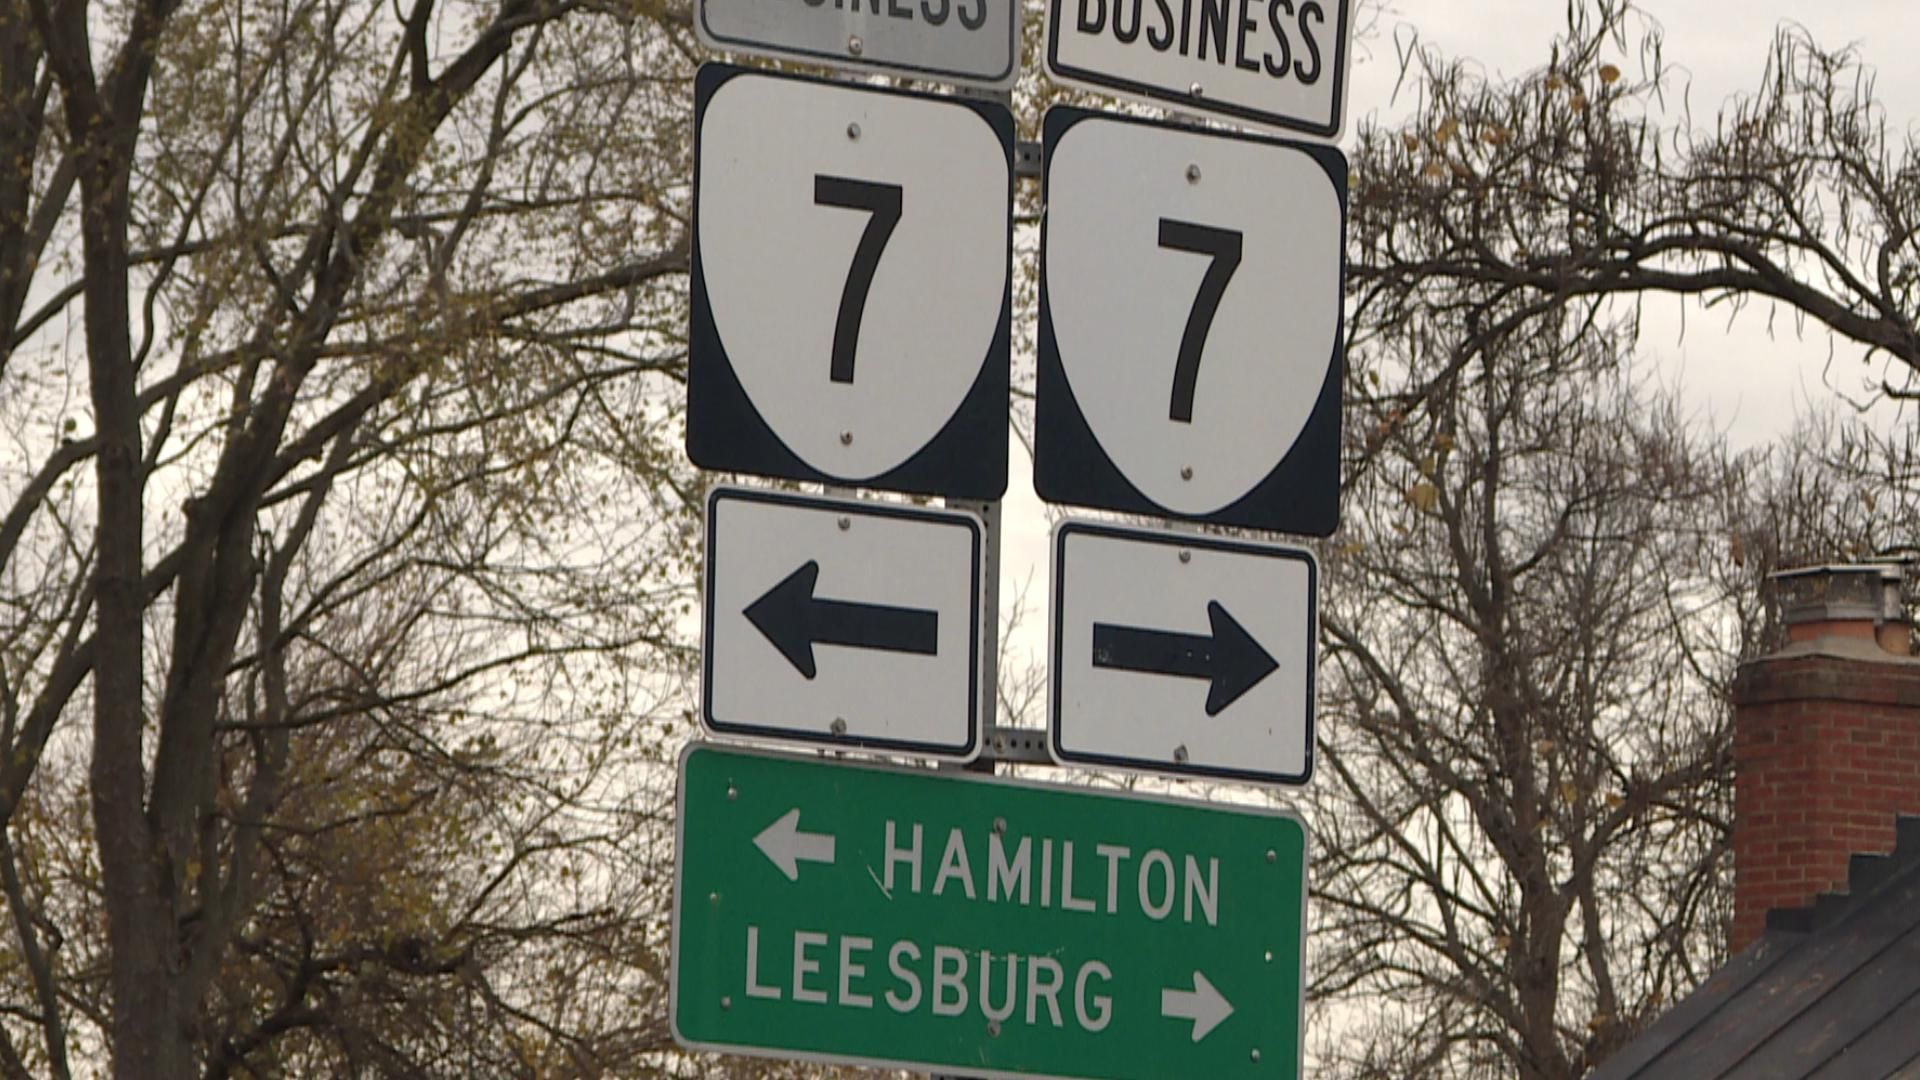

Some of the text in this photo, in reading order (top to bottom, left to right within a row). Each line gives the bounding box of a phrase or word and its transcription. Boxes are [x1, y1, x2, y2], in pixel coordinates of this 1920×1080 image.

[813, 173, 903, 385] 7
[1158, 217, 1243, 424] 7
[883, 819, 1220, 926] HAMILTON
[745, 926, 1114, 1032] LEESBURG
